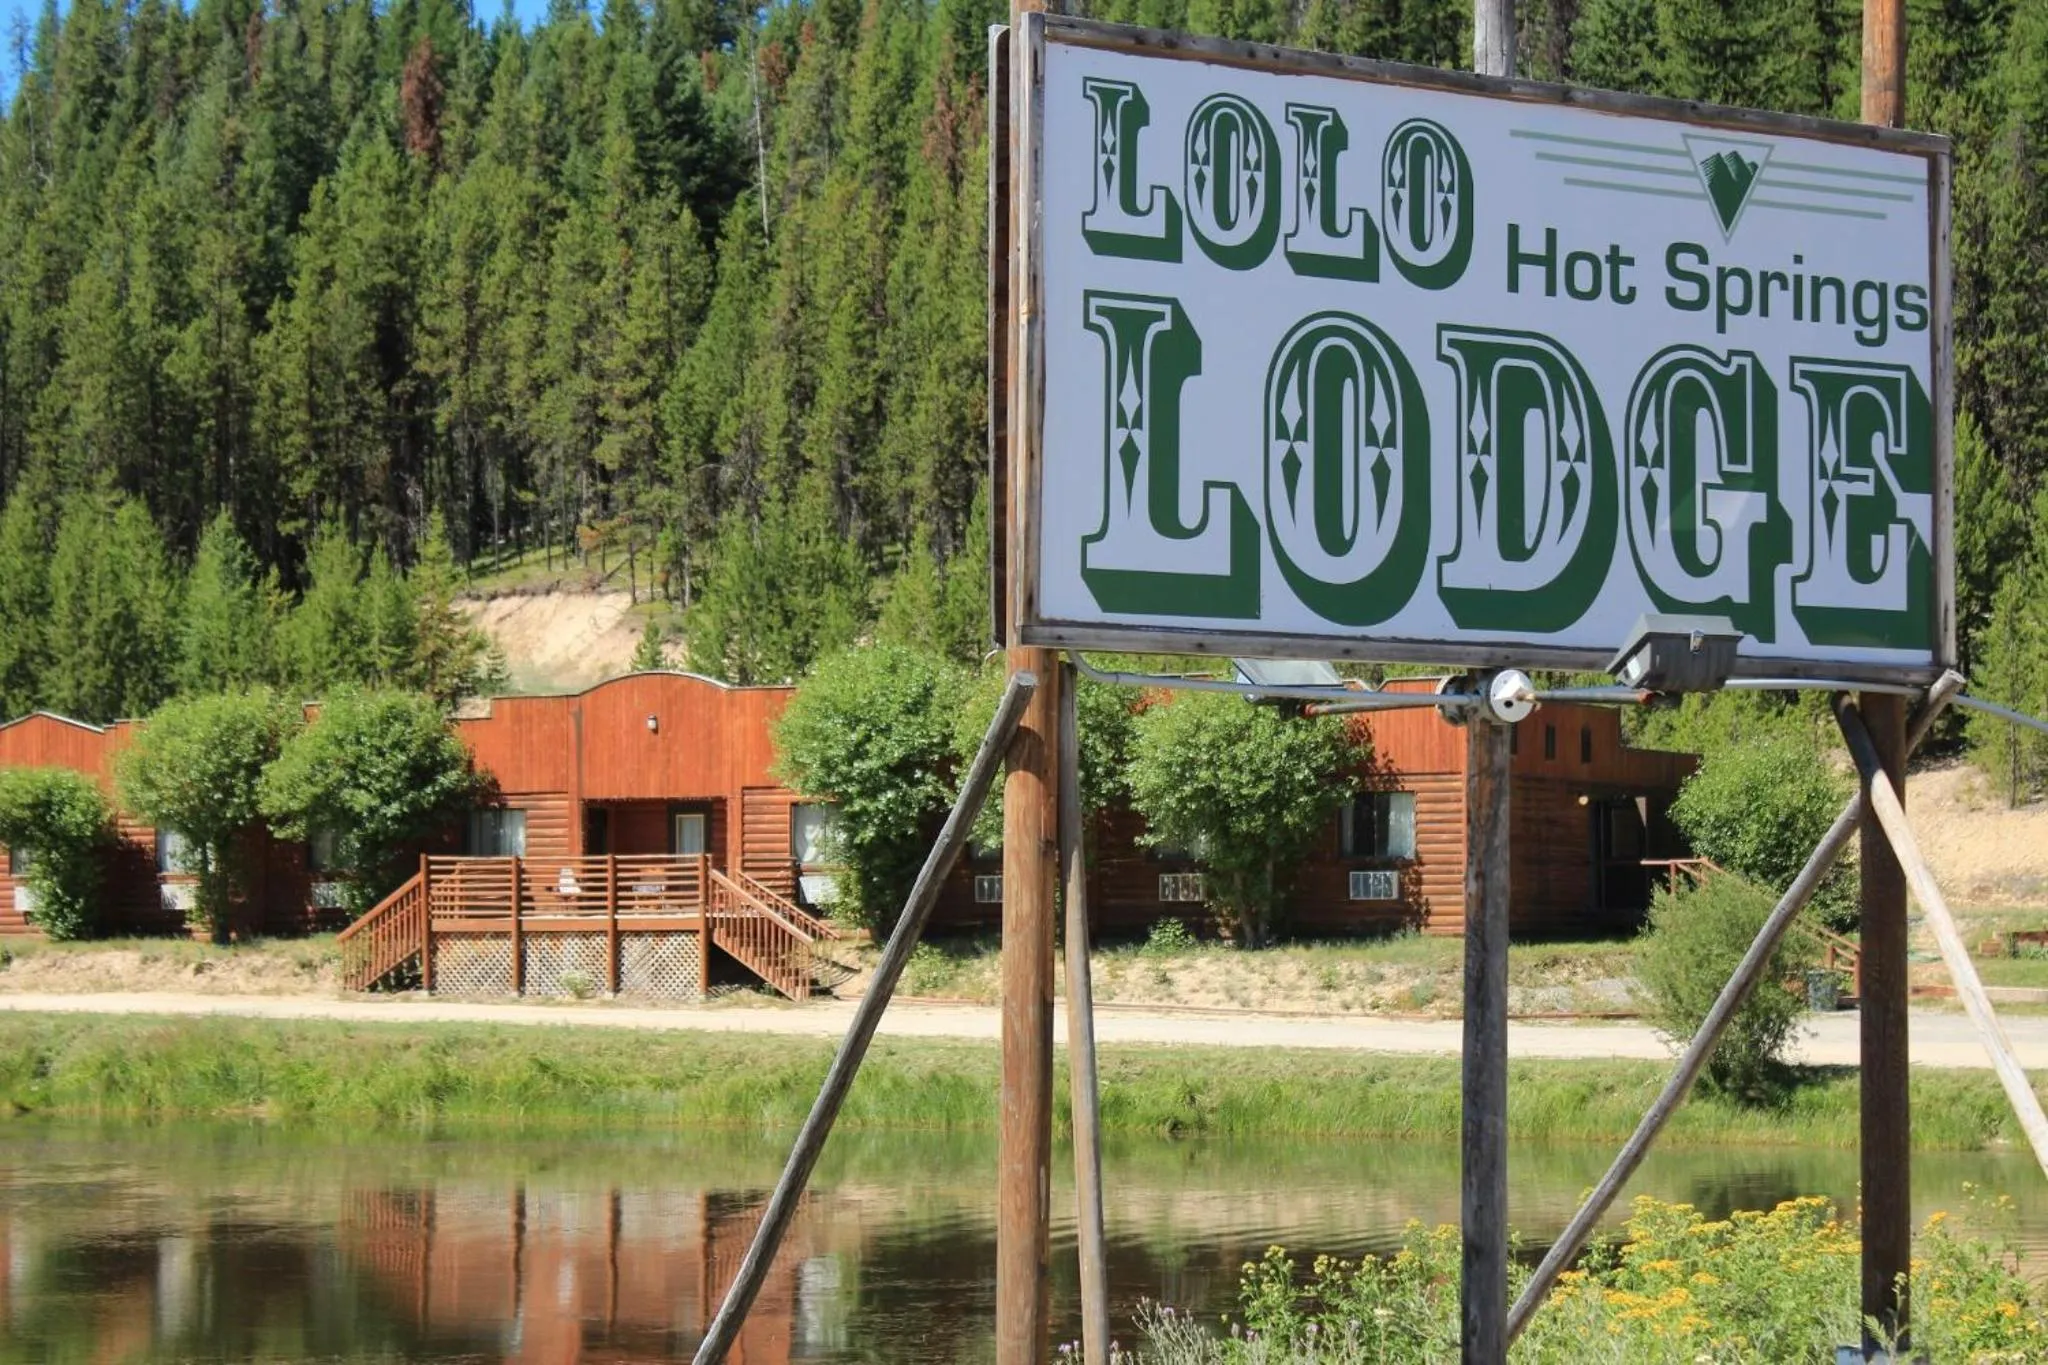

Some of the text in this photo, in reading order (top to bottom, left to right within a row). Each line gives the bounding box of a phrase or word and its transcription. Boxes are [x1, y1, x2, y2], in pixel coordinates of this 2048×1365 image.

[1082, 76, 1930, 347] LOLO Hot Springs
[1081, 289, 1932, 650] LODGE
